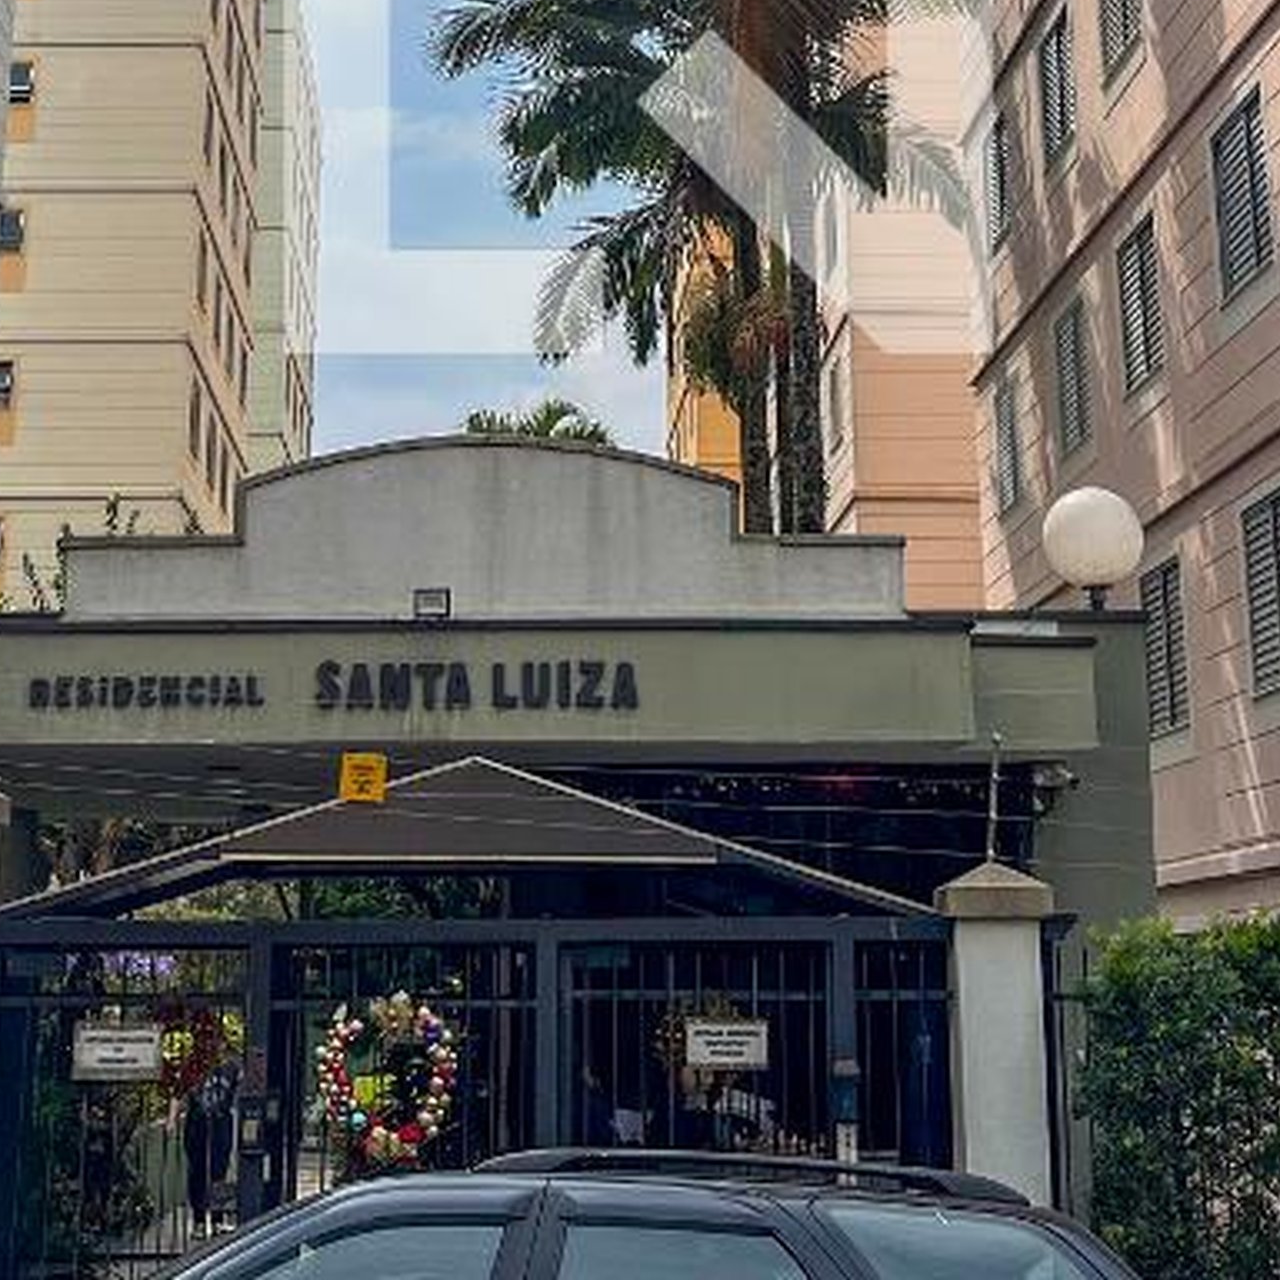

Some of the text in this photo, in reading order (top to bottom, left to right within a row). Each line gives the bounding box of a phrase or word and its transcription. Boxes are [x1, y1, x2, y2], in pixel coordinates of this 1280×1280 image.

[28, 659, 639, 711] RESIDENCIAL SANTA LUIZA
